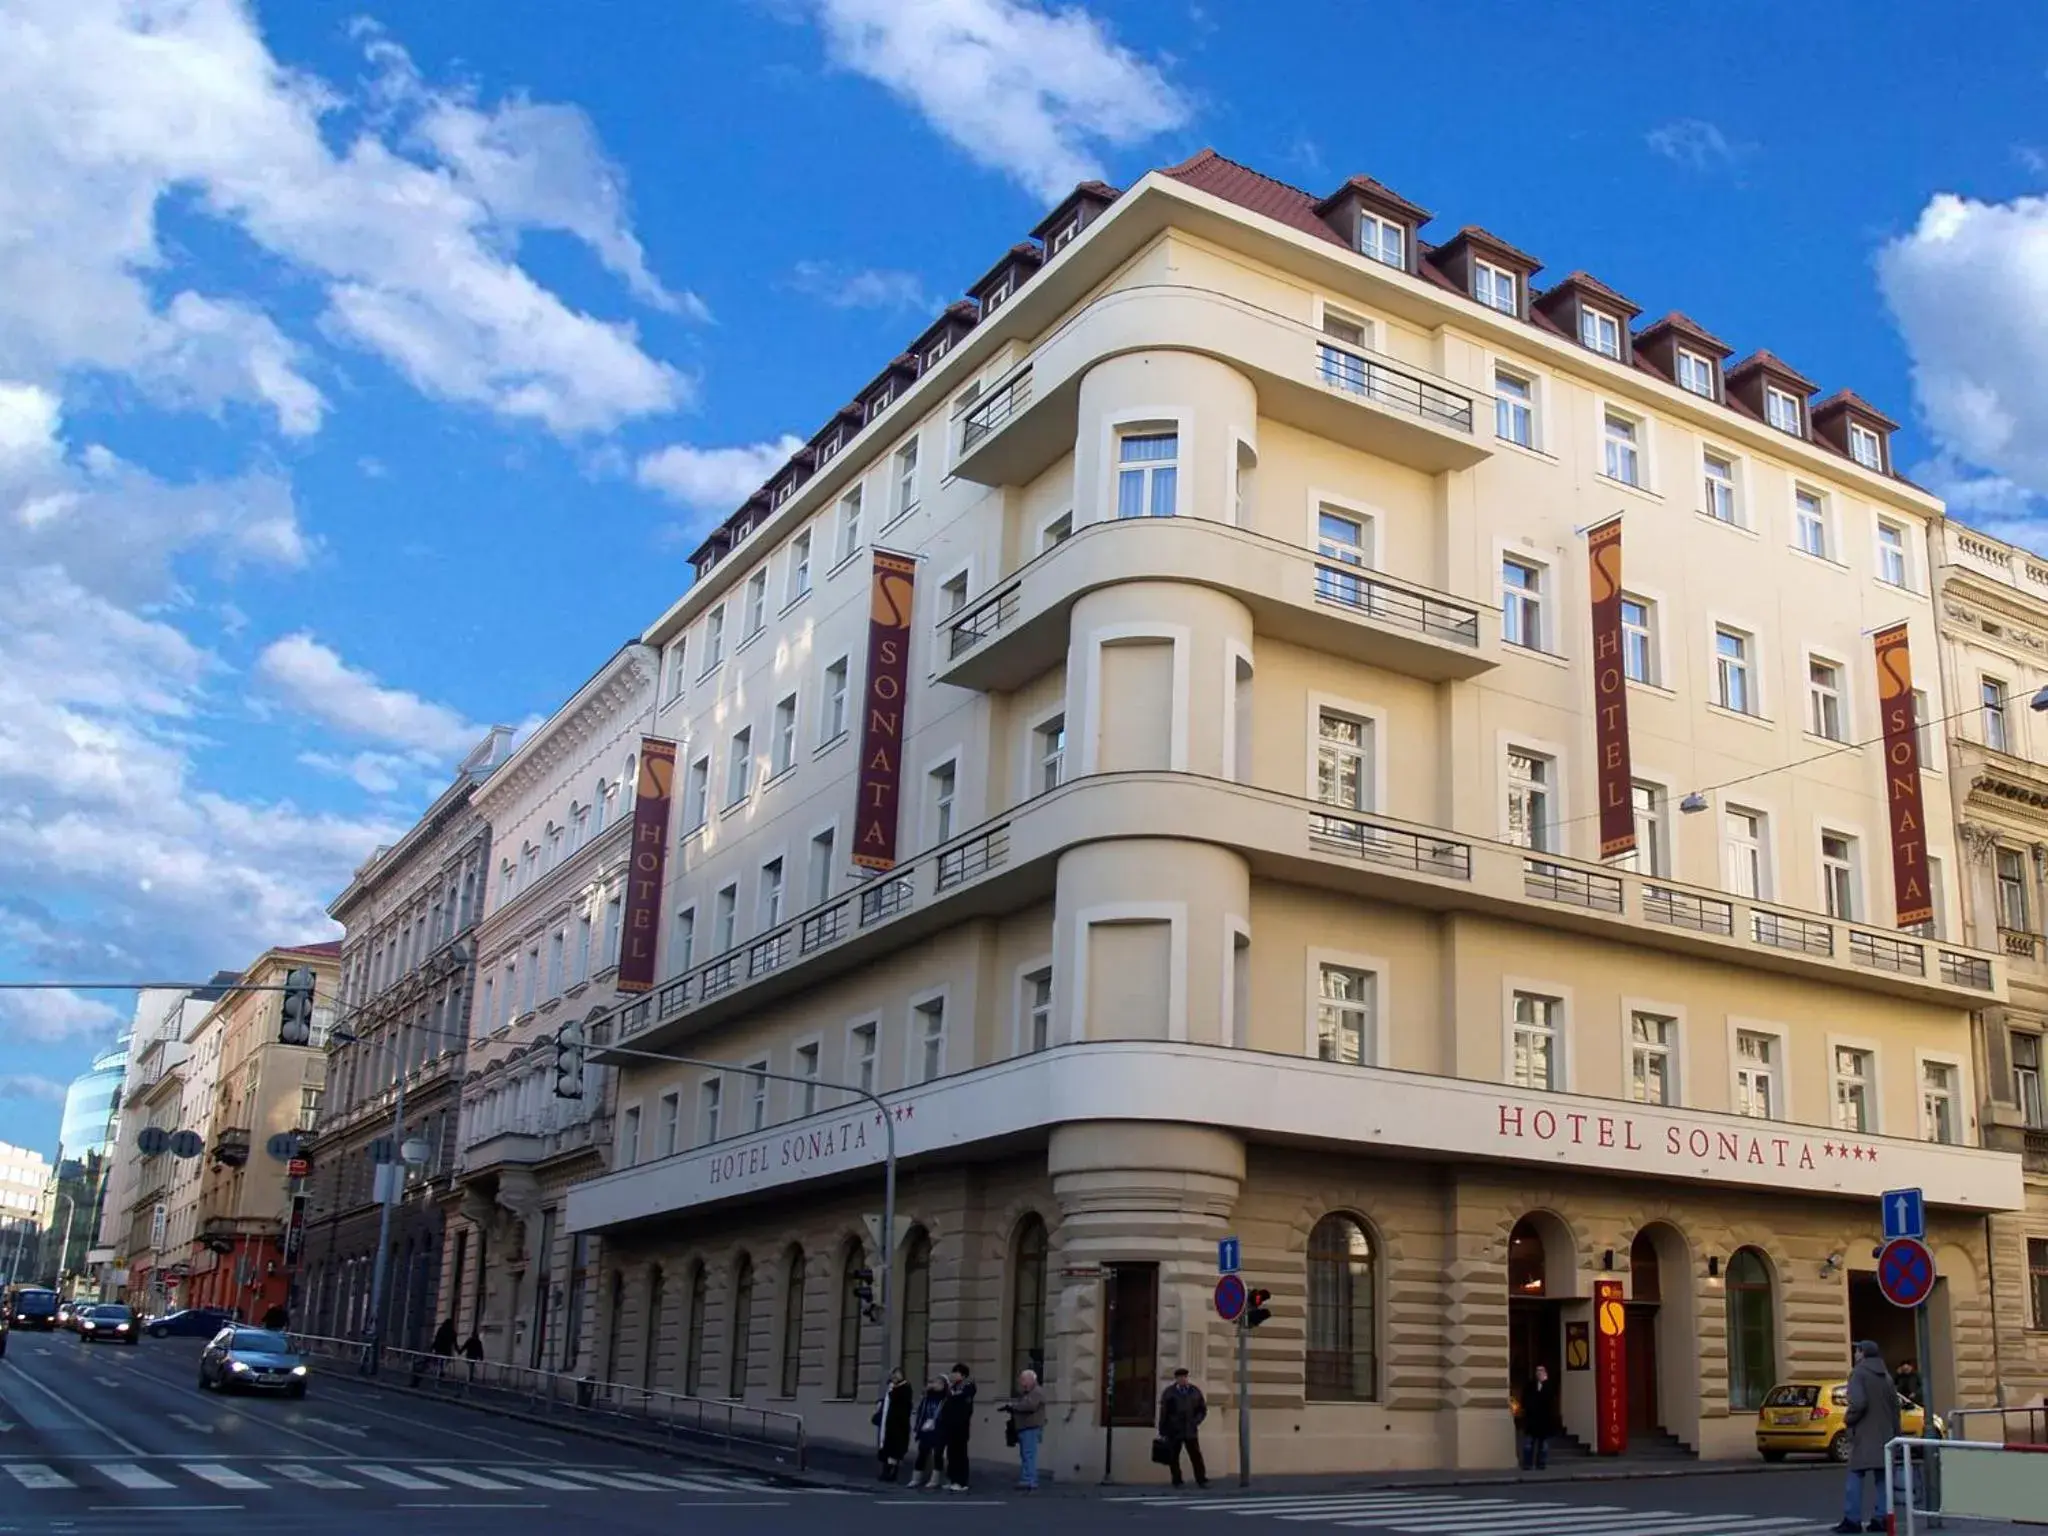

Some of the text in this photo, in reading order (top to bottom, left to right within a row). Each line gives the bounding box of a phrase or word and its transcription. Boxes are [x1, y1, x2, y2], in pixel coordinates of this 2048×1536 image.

[863, 640, 899, 847] SONATA
[1598, 629, 1624, 809] HOTEL
[1890, 708, 1922, 901] SONATA
[631, 822, 661, 959] HOTEL
[709, 1121, 866, 1184] HOTEL SONATA
[1499, 1105, 1816, 1170] HOTEL SONATA
